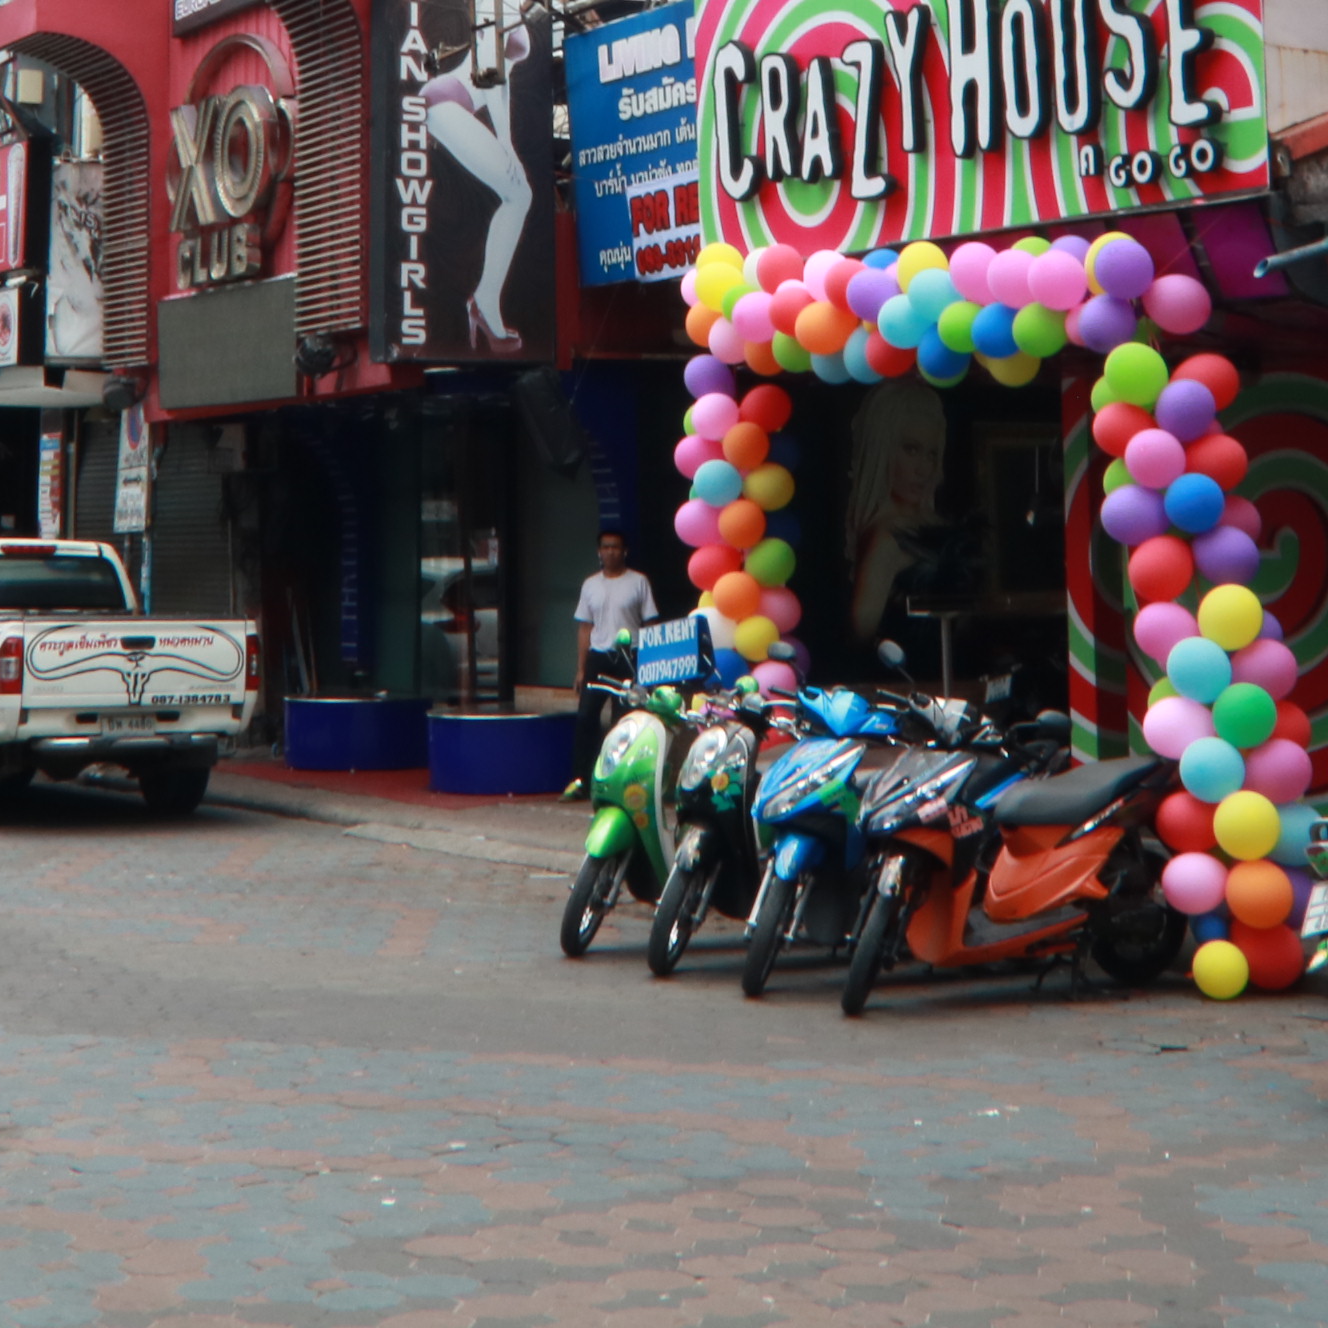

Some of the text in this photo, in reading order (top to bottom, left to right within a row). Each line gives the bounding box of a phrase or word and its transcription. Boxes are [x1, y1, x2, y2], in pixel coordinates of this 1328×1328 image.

[712, 4, 930, 202] CRAZY
[169, 83, 276, 232] XO
[1080, 138, 1217, 188] A GO GO
[395, 94, 433, 346] SHOWGIRLS
[630, 189, 670, 238] FOR
[176, 222, 260, 290] CLUB
[638, 617, 697, 651] FOR RENT
